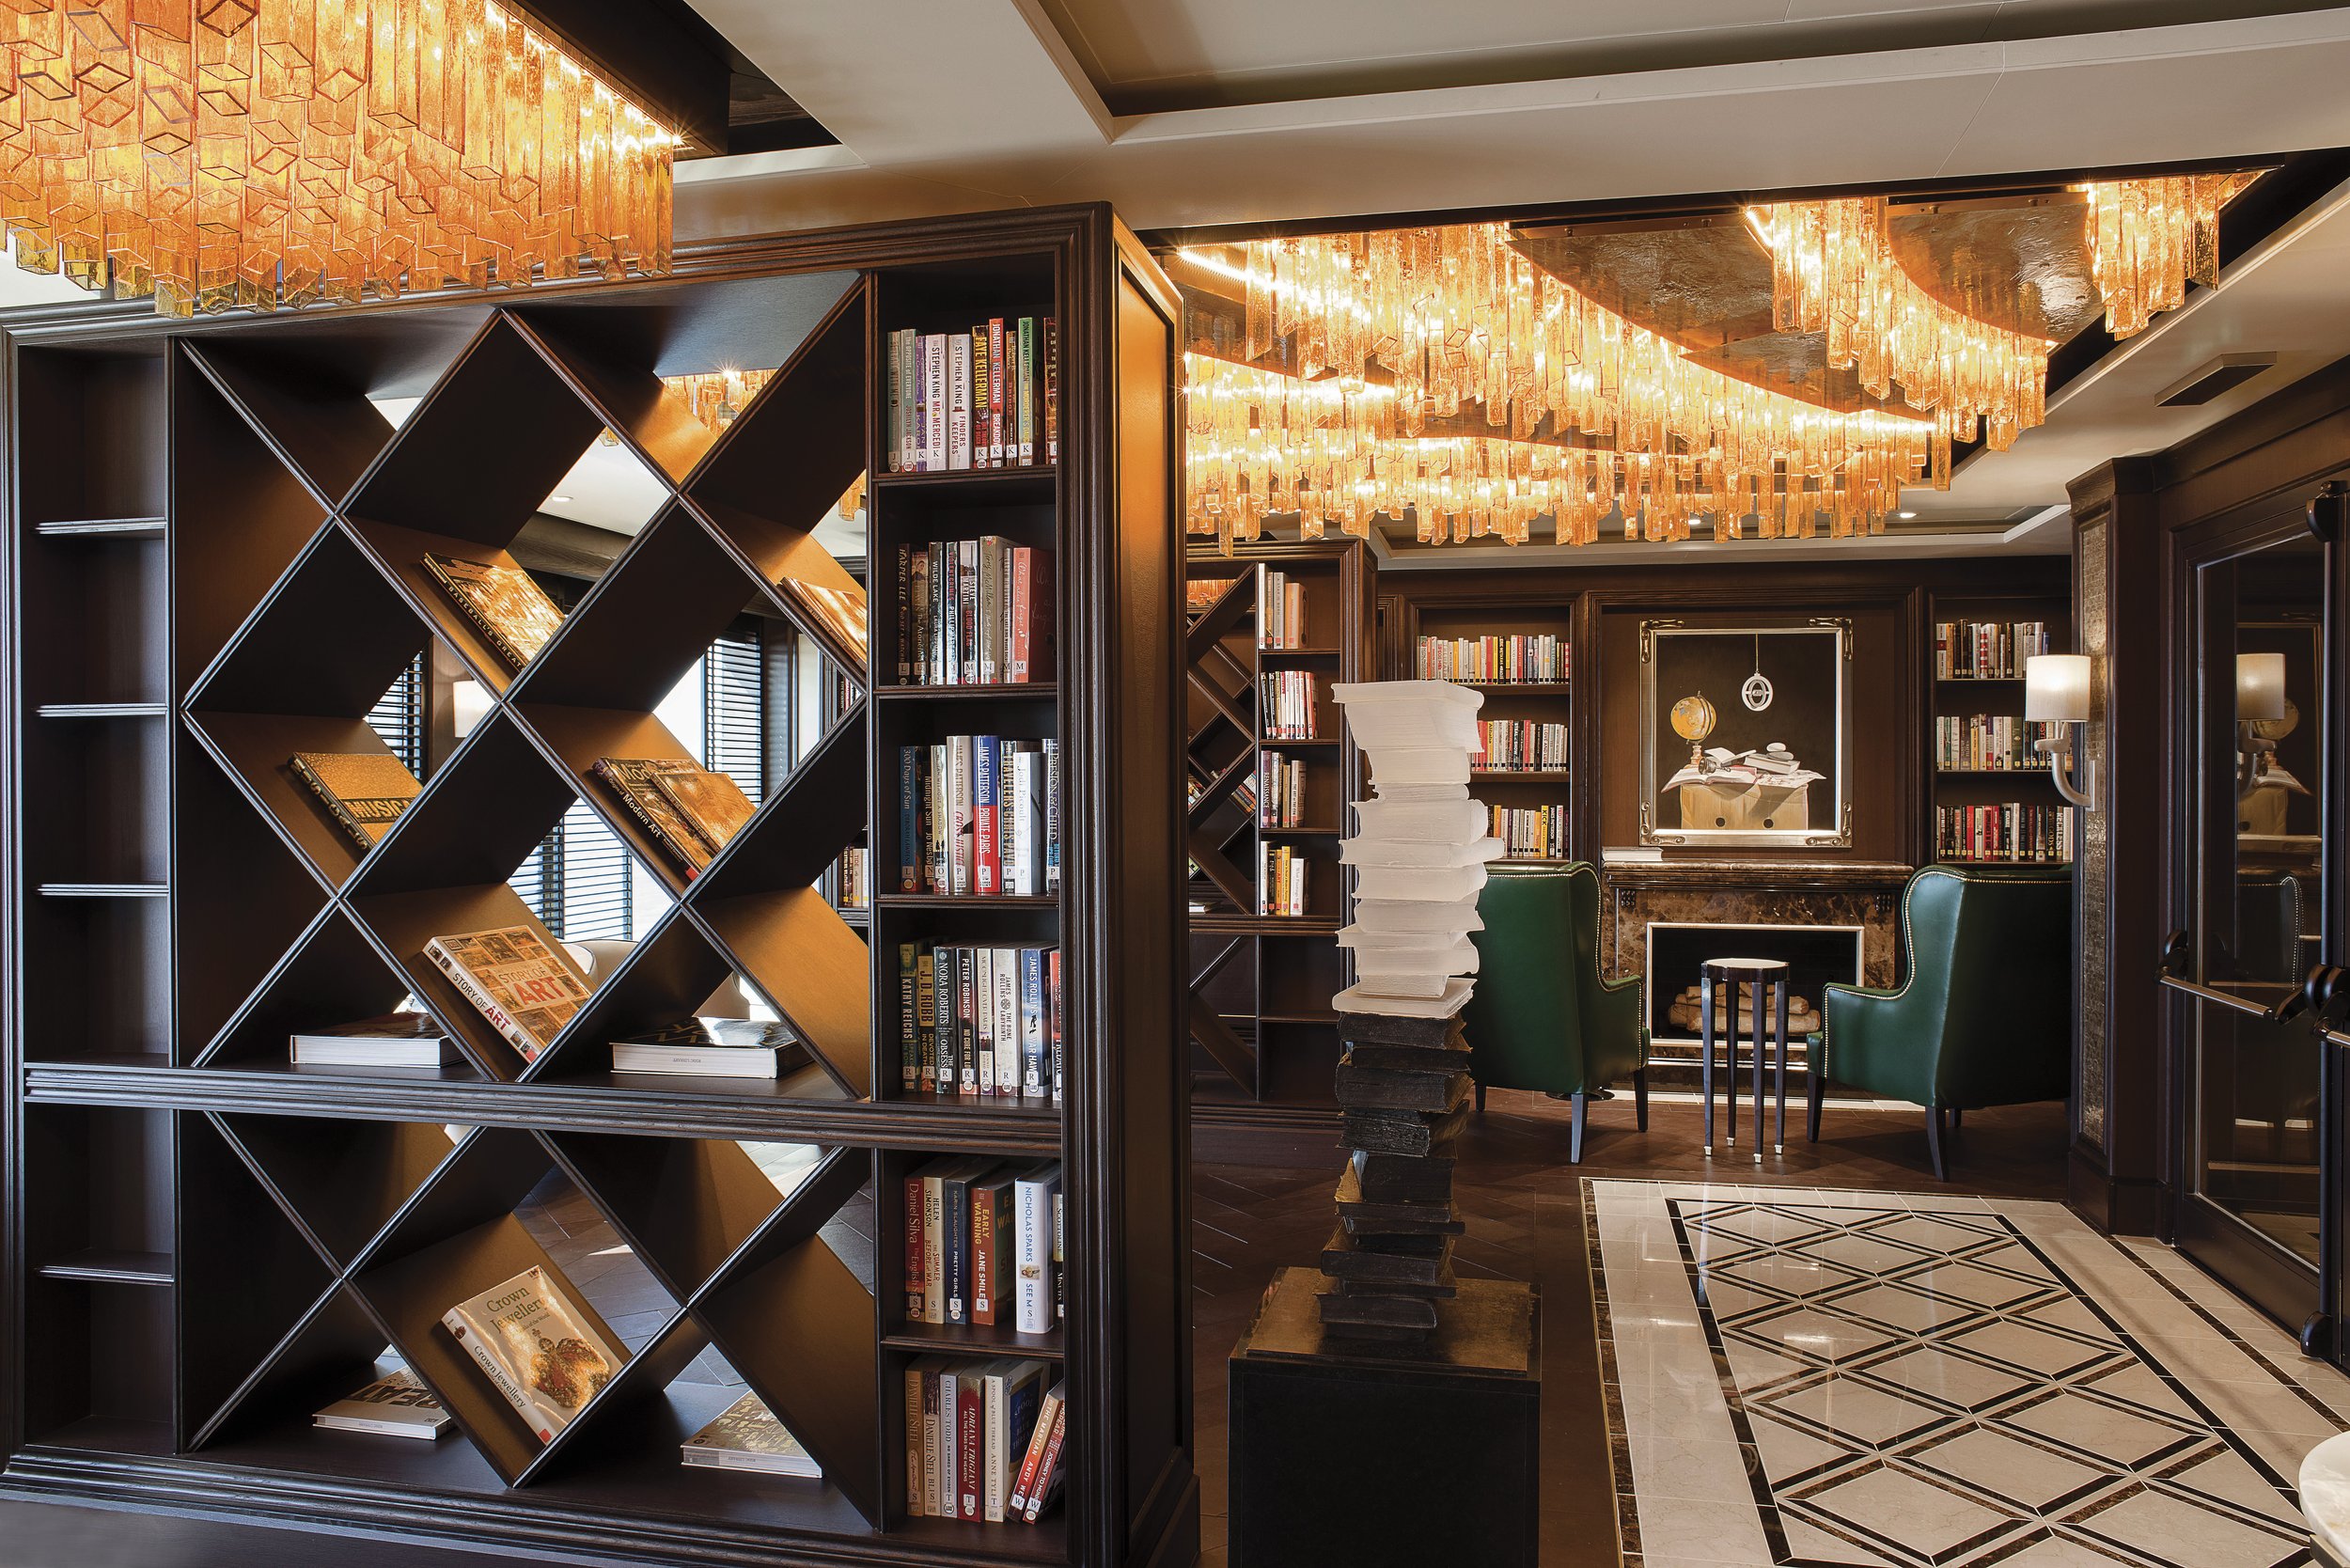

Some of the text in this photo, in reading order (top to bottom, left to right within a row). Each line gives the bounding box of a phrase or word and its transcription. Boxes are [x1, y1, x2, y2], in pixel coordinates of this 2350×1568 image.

[932, 347, 940, 399] STEPHEN KING
[975, 337, 987, 408] FAYE KELLERMAN
[993, 323, 1001, 404] JONATHAN KELLERMAN
[899, 548, 907, 601] HARPER LEE
[983, 572, 994, 607] McMillan
[447, 585, 494, 636] BASEBALL'S
[902, 749, 911, 809] 300 Days of Sun
[923, 776, 932, 809] Midnight
[979, 746, 990, 804] JAMES PATTERSON
[1003, 756, 1015, 808] TRAVELERS
[1017, 766, 1026, 823] Jodi Picoult
[1049, 753, 1059, 795] PRESTON
[290, 758, 368, 850] MUSICALS
[622, 793, 650, 825] Modern
[648, 823, 662, 839] Art
[955, 811, 964, 838] CROSS
[1049, 807, 1059, 840] CHILD
[979, 808, 990, 854] PRIVATE PARIS
[498, 970, 530, 984] STORY
[531, 965, 548, 980] OF
[511, 976, 566, 1006] ART
[920, 970, 932, 1026] J. D. ROBB
[939, 963, 948, 1024] NORA ROBERTS
[962, 958, 970, 1018] PETER ROBINSON
[1029, 956, 1038, 1015] JAMES ROLLINS
[452, 973, 512, 1030] STORY OF ART
[902, 979, 912, 1039] KATHY REICHS
[940, 1039, 948, 1067] OBSESS
[1028, 1037, 1038, 1053] WAR
[905, 1067, 912, 1075] R
[908, 1183, 920, 1244] Daniel Silva
[974, 1201, 982, 1245] WARNING
[908, 1256, 920, 1285] English
[486, 1286, 530, 1313] Crown
[931, 1300, 936, 1309] S
[979, 1300, 985, 1309] S
[1026, 1309, 1033, 1318] S
[473, 1344, 526, 1408] Crown Jewellery
[502, 1388, 514, 1403] World
[909, 1378, 920, 1442] DANIELLE STEEL
[1031, 1405, 1053, 1456] THE MARTIAN
[926, 1419, 935, 1475] DANIELLE STEEL
[968, 1403, 977, 1490] ADRIANA TRIGIANI
[1023, 1460, 1033, 1482] ANDY
[1040, 1450, 1053, 1485] JOURNEY TO
